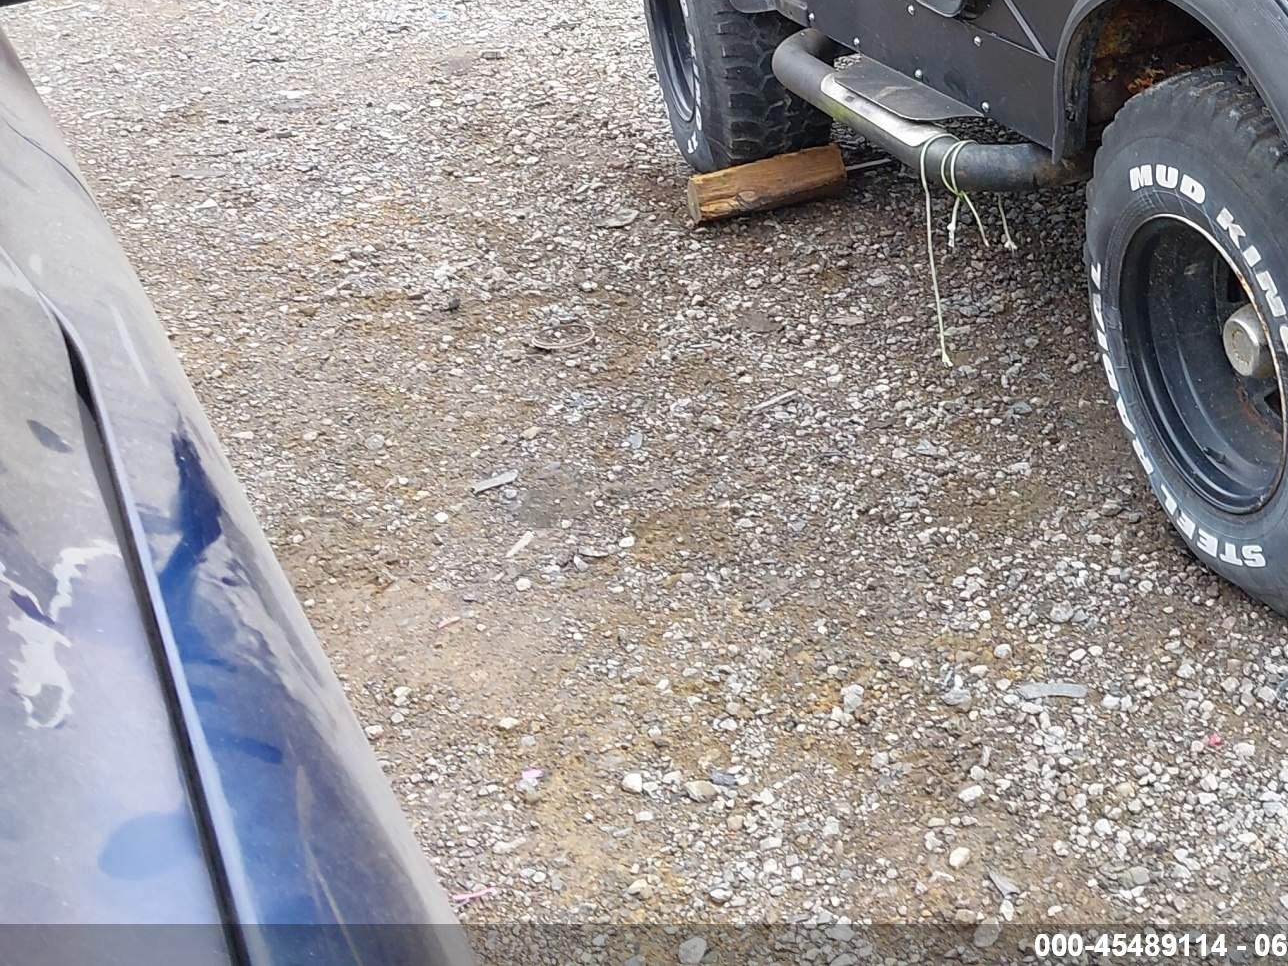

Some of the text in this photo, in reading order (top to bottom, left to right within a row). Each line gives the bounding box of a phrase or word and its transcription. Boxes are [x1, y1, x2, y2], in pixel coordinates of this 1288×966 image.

[1129, 163, 1206, 205] MUD
[1090, 262, 1267, 568] STEEL RADIAL
